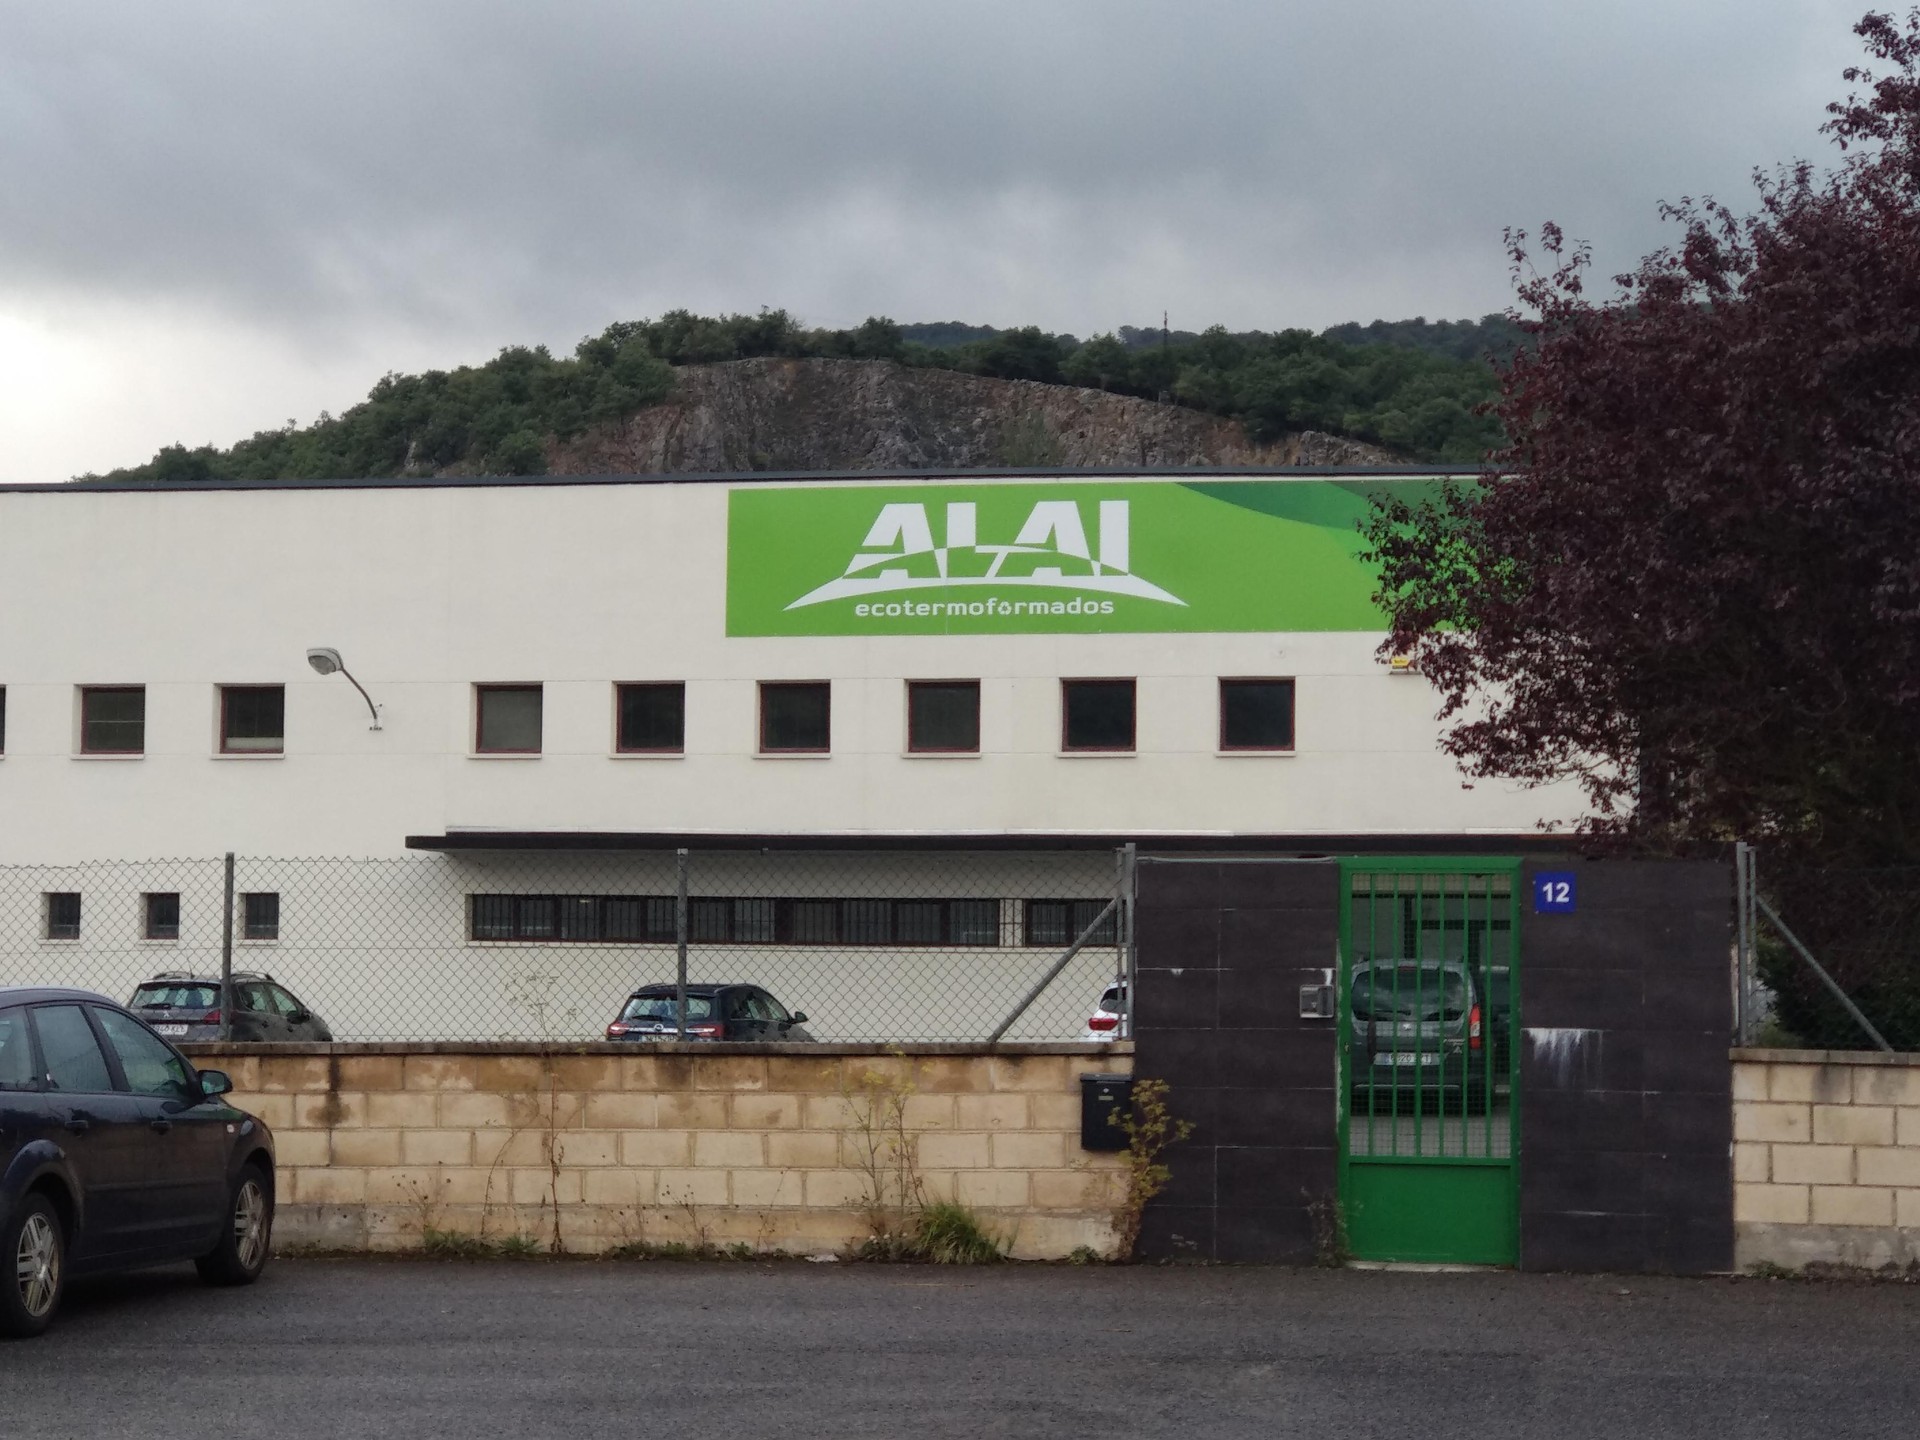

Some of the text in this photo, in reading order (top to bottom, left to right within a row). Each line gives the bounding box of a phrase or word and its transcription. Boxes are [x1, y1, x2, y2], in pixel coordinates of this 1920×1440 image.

[842, 500, 1129, 580] ALAI
[855, 597, 1115, 617] ecotermoformados
[1542, 881, 1570, 903] 12
